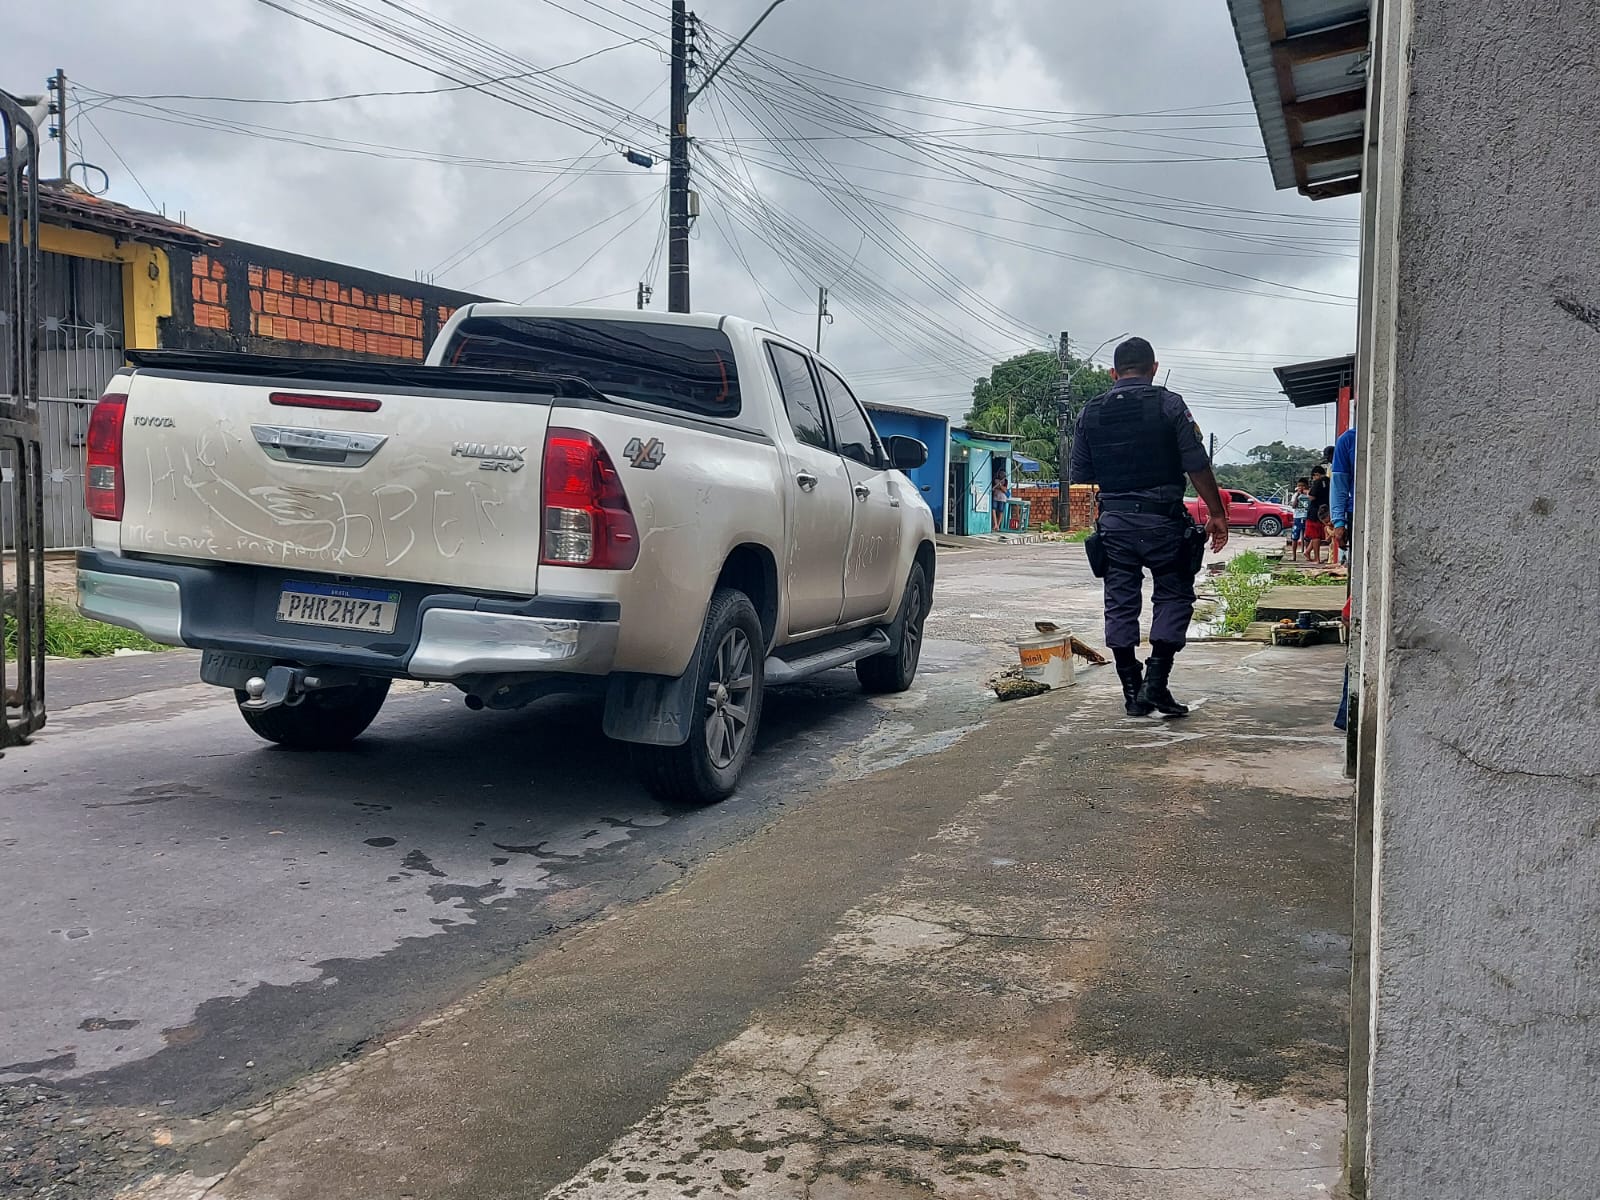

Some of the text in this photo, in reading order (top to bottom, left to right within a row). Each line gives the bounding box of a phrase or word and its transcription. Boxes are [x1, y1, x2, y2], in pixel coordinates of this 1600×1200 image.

[133, 416, 176, 428] TOYOTA
[451, 441, 528, 461] HILUX
[479, 460, 525, 473] SRV
[288, 594, 383, 627] PHR2H71
